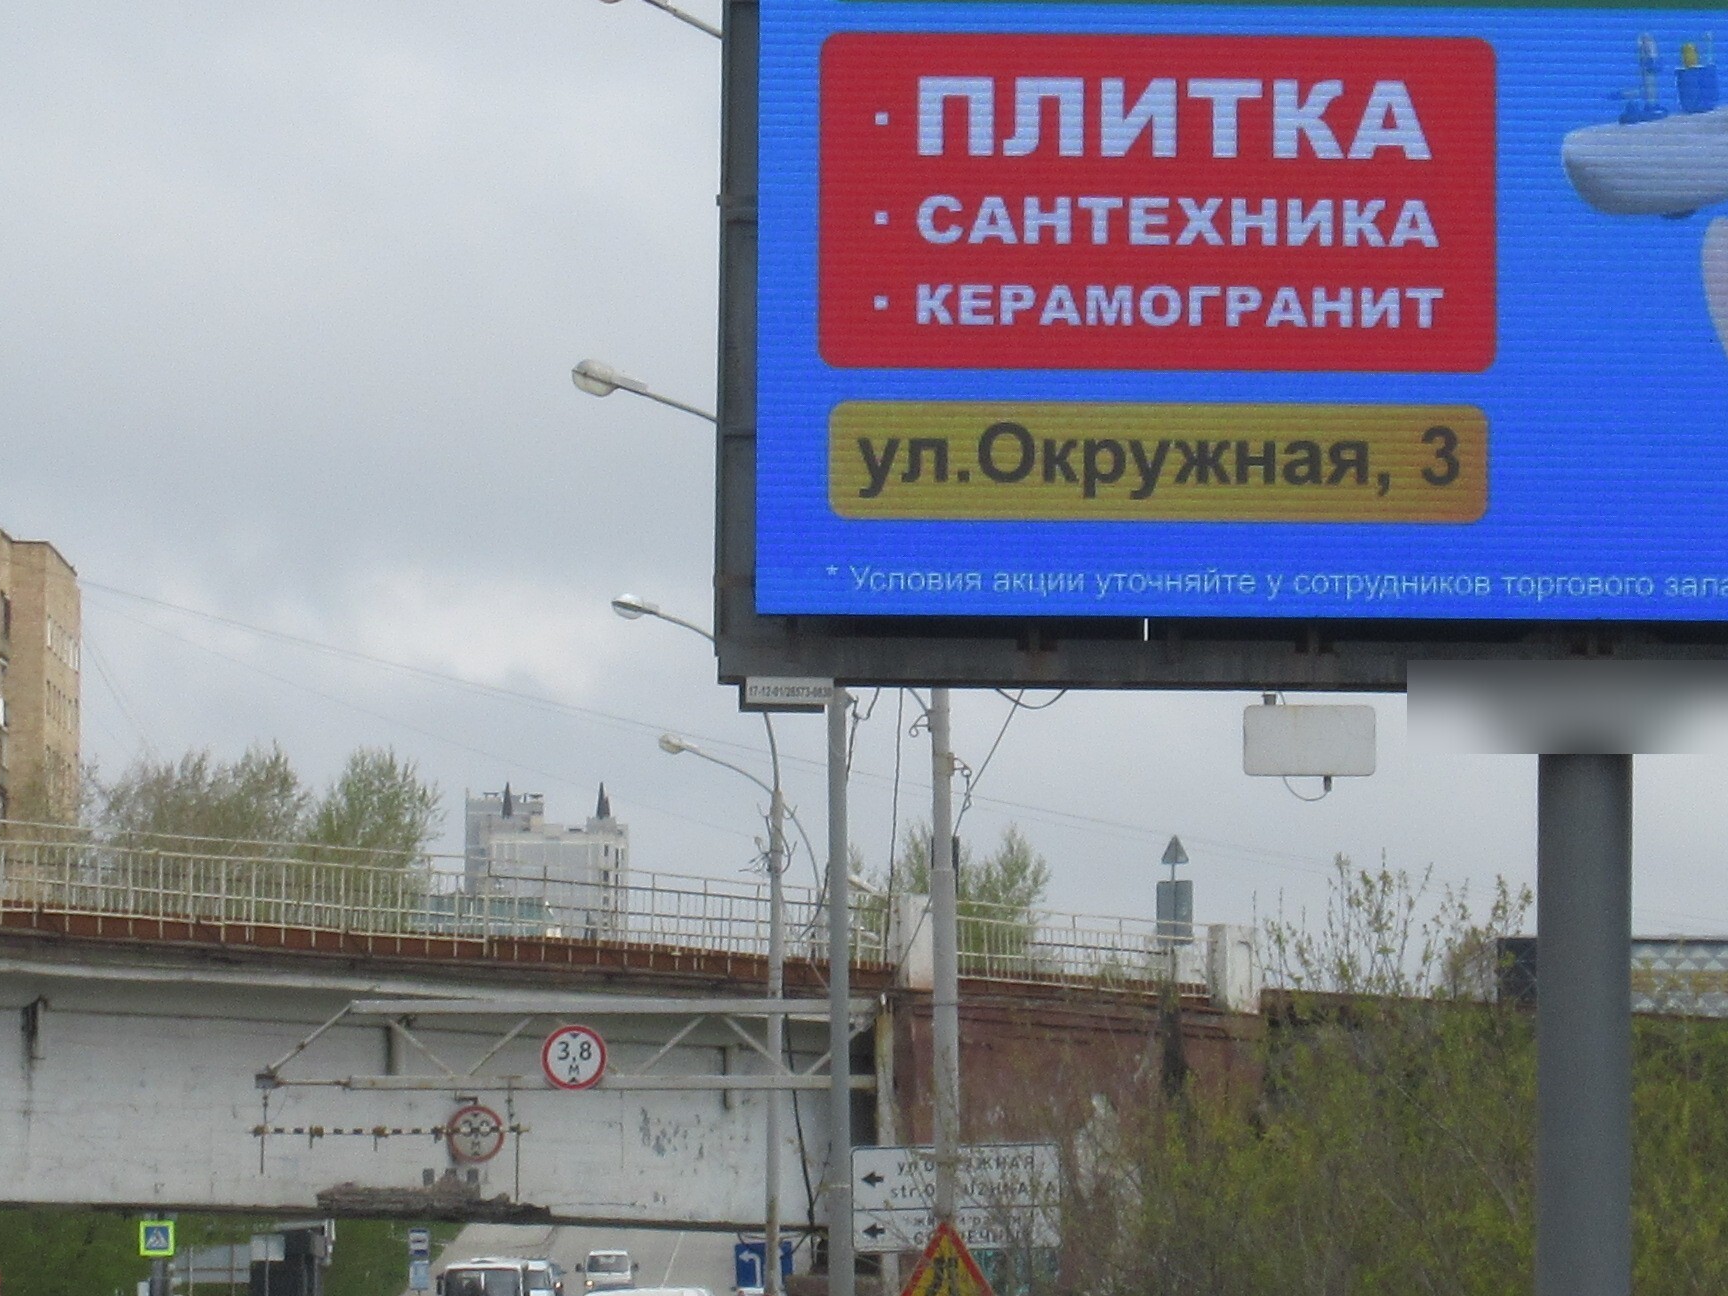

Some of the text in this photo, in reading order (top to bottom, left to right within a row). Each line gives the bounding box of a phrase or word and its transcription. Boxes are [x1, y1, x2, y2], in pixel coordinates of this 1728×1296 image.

[916, 75, 1433, 161] ПЛИТКА
[916, 195, 1440, 249] САНТЕХНИКА
[916, 283, 1445, 330] КЕРАМОГРАНИТ
[1419, 425, 1461, 488] 3
[849, 565, 983, 594] Условия
[992, 572, 1085, 598] акции
[1095, 568, 1256, 597] уточняйте
[1266, 573, 1281, 600] у
[1293, 572, 1491, 601] сотрудников
[1501, 572, 1655, 602] торгового
[557, 1041, 592, 1063] 3,8
